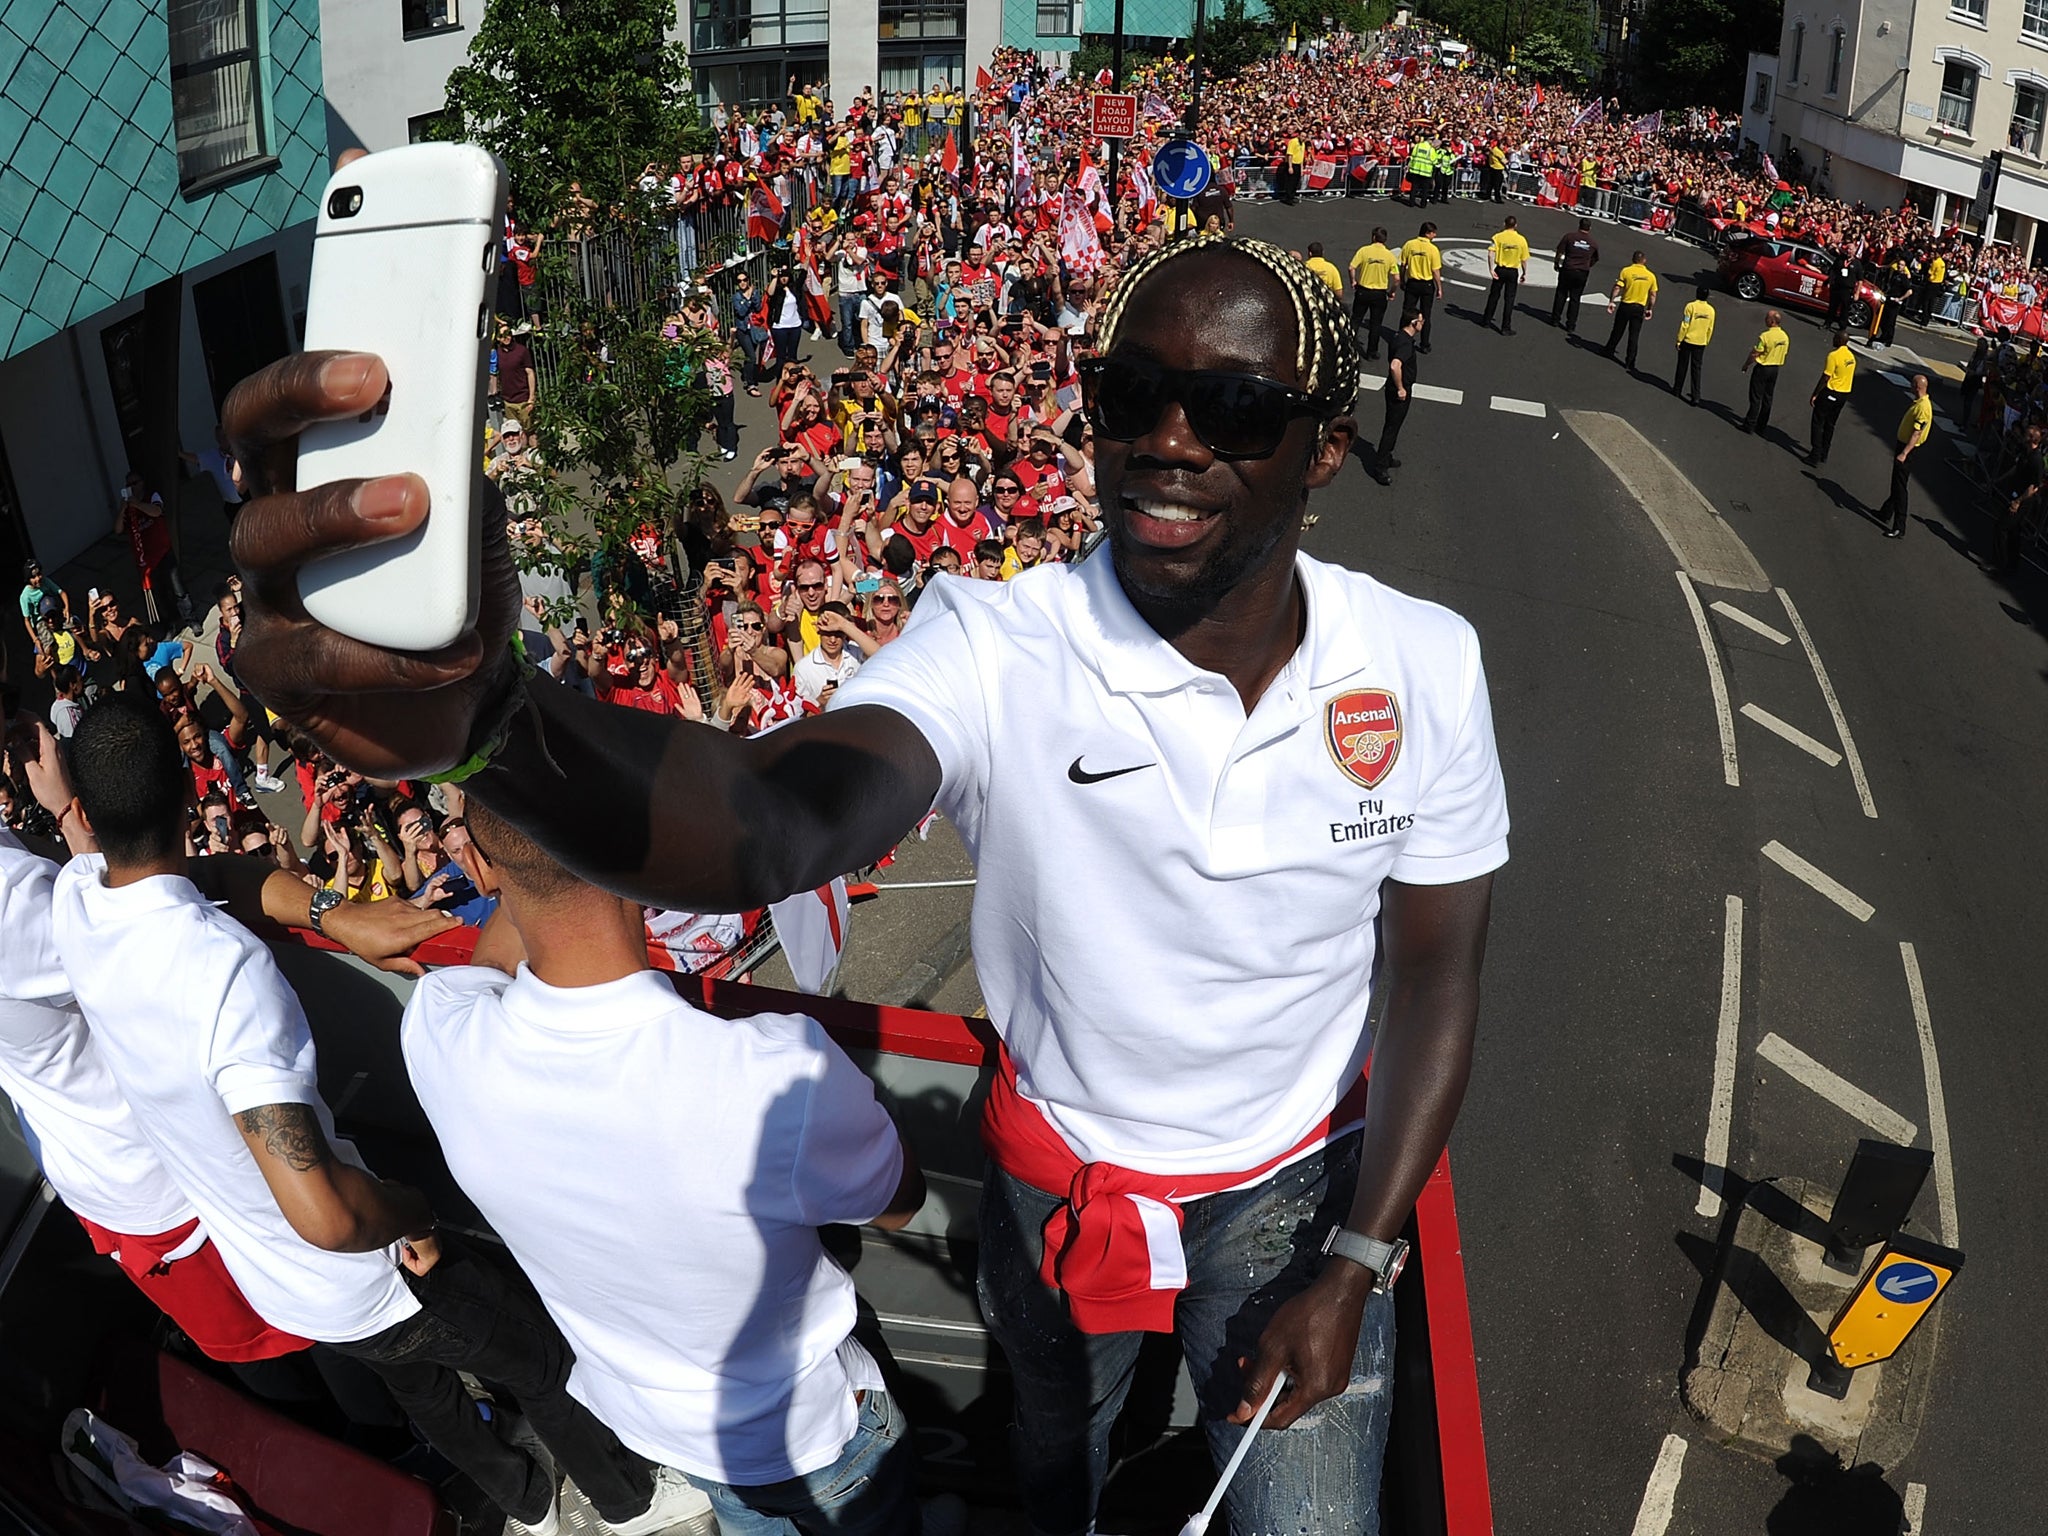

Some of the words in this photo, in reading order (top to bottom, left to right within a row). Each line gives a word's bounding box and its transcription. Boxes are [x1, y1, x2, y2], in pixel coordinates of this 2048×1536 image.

[1103, 98, 1126, 107] NEW
[1101, 107, 1128, 116] ROAD
[1096, 116, 1132, 125] LAYOUT
[1097, 124, 1130, 133] AHEAD
[1078, 209, 1097, 241] WINNERS
[1335, 706, 1391, 725] Arsenal
[1358, 799, 1383, 816] Fly
[1329, 813, 1416, 843] Emirates
